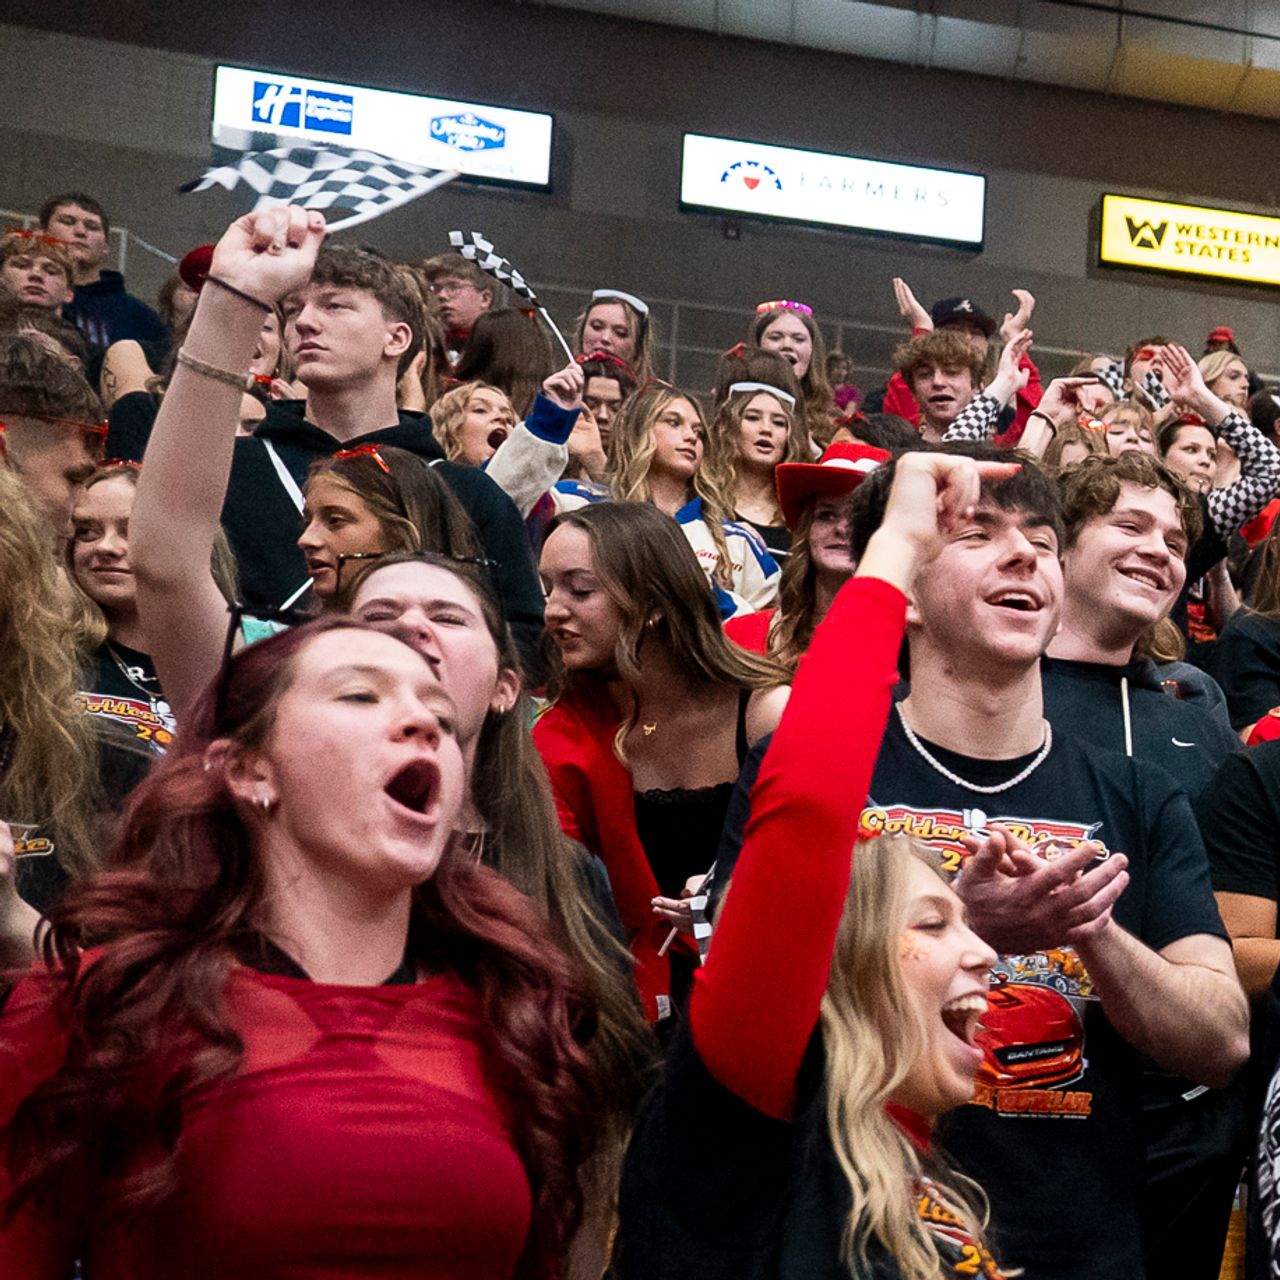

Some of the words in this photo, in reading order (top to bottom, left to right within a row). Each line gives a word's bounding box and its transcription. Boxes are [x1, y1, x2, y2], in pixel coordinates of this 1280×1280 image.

[799, 171, 949, 206] FARMERS
[1175, 221, 1280, 249] WESTERN
[1174, 241, 1252, 264] STATES
[84, 698, 157, 723] olden
[861, 807, 967, 842] Golden
